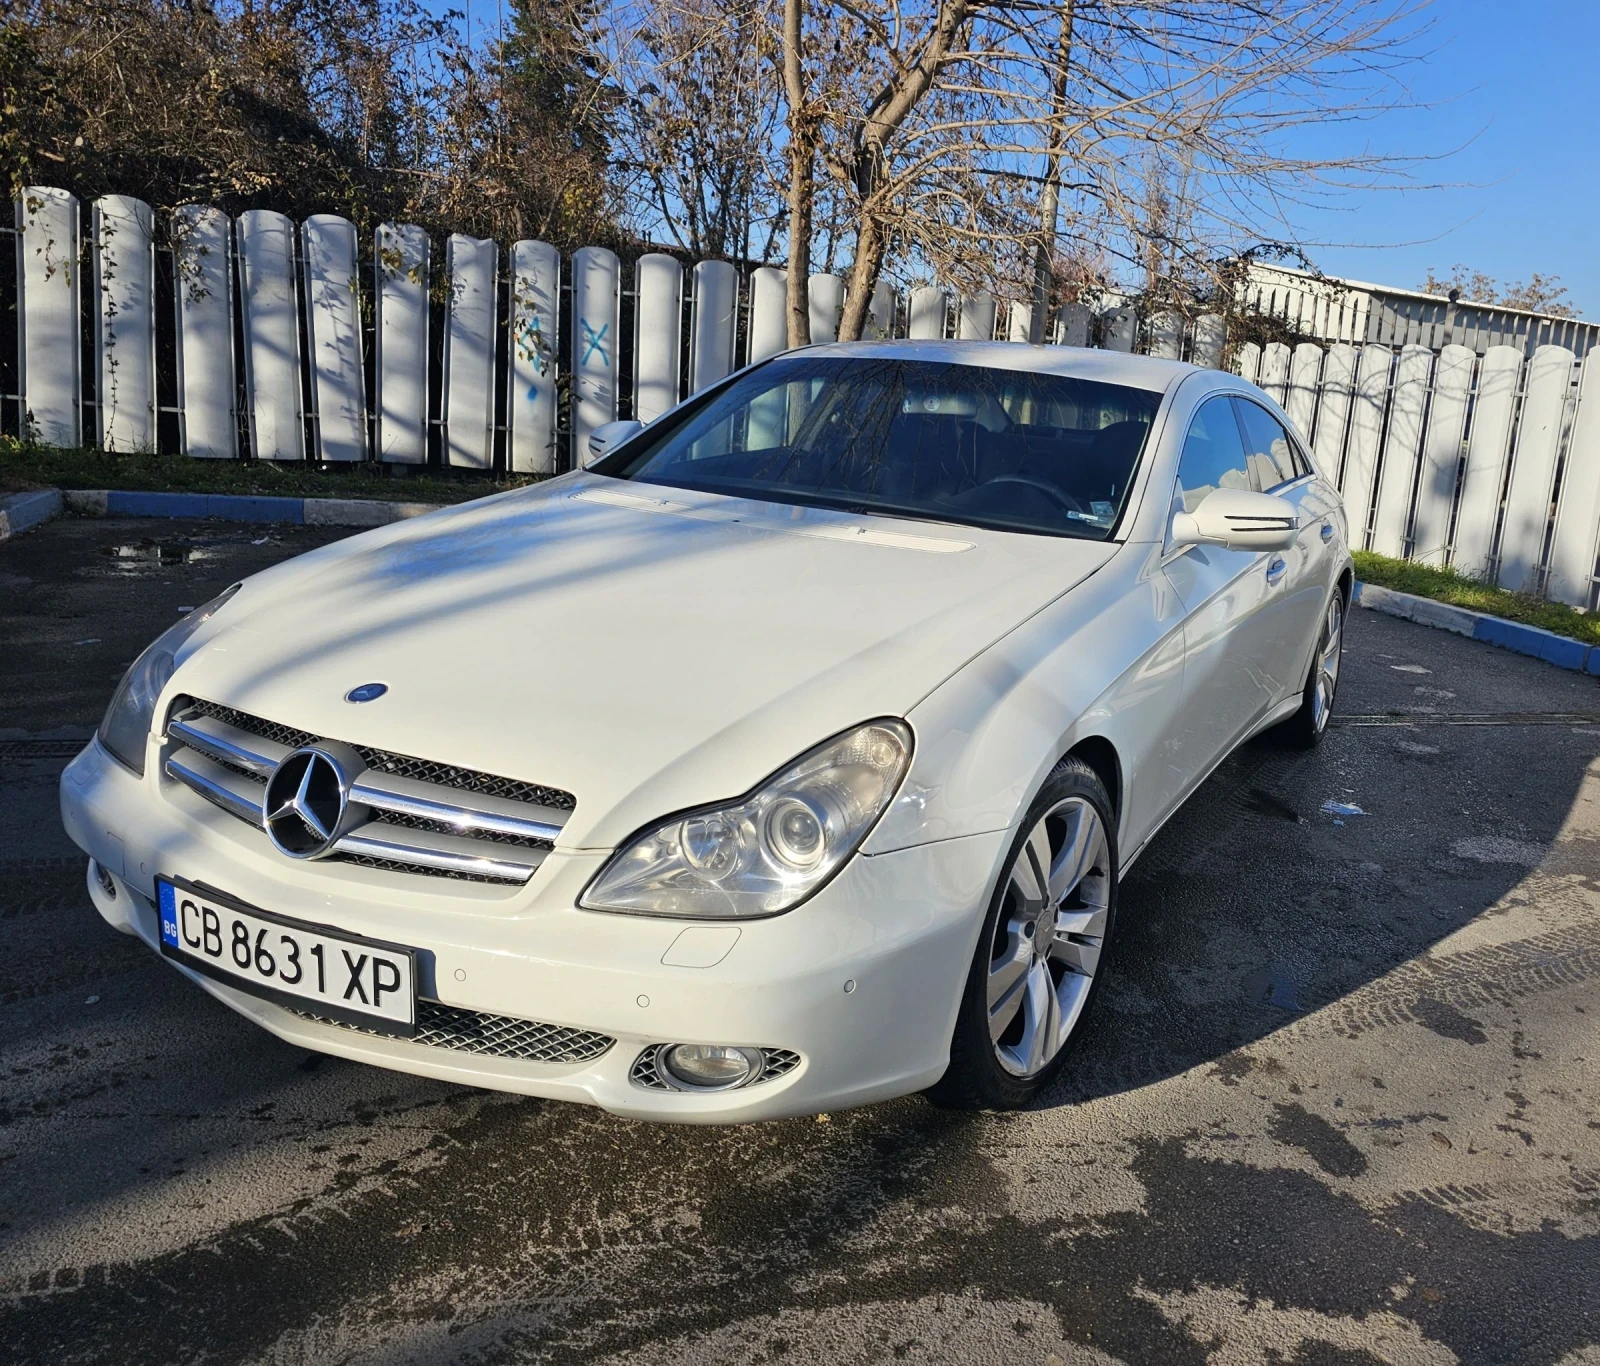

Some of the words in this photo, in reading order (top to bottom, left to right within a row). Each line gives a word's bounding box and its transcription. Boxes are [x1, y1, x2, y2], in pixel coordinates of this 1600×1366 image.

[164, 920, 177, 938] BG
[181, 900, 223, 957] CB
[232, 920, 325, 994] 8631
[341, 949, 401, 1007] XP
